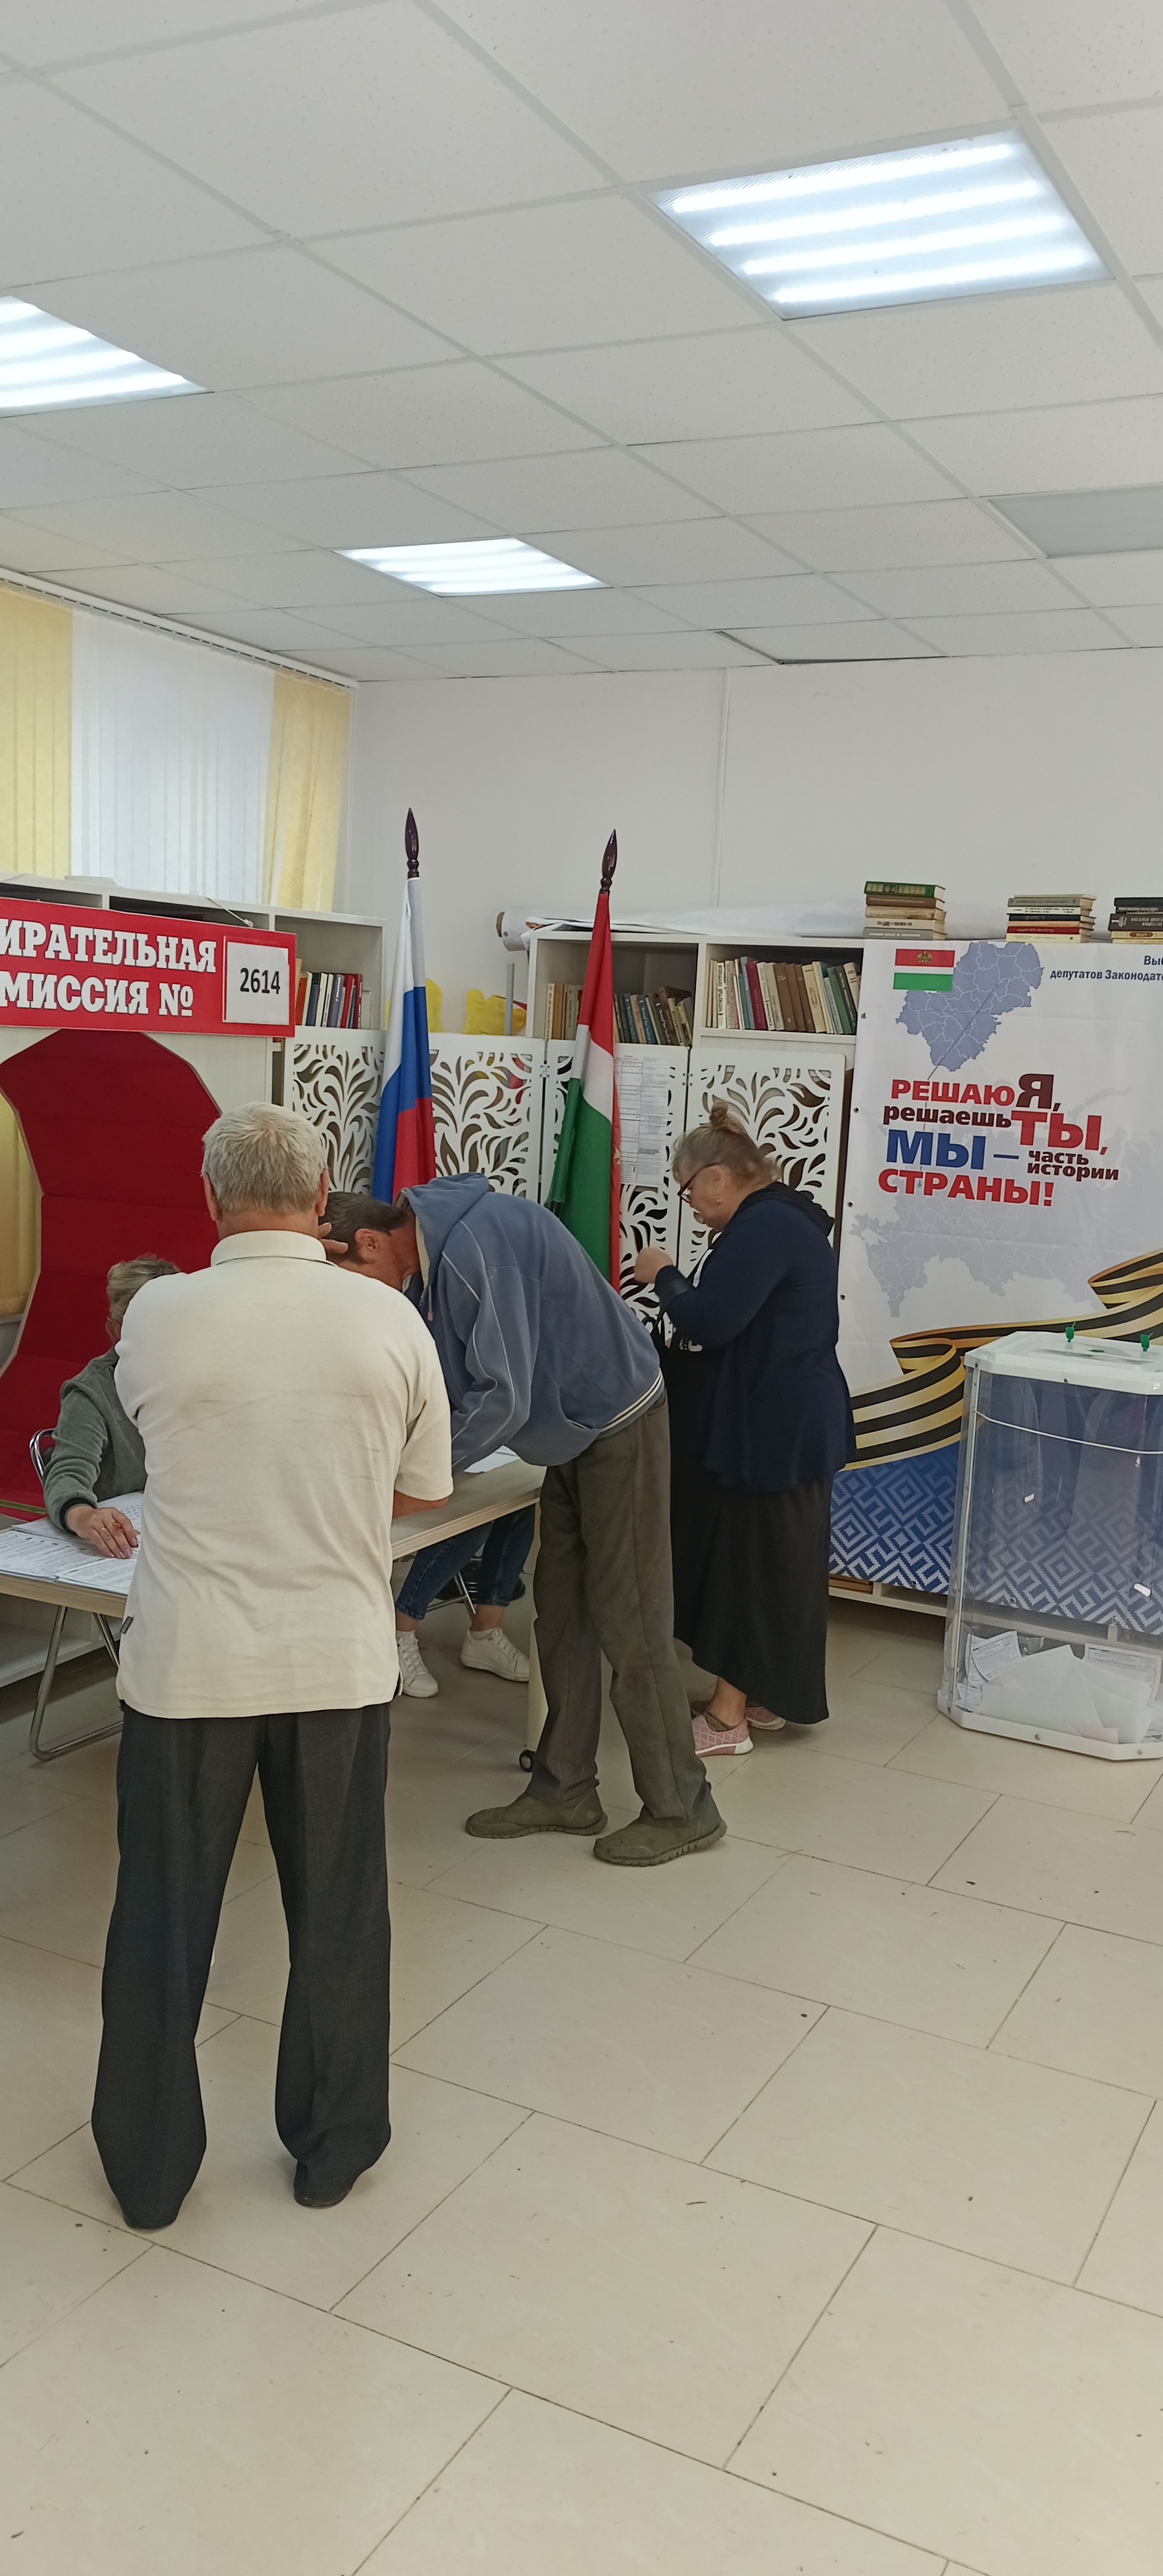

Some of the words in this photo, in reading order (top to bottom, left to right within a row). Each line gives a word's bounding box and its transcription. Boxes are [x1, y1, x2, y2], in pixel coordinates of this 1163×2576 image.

[0, 918, 216, 973] ИРАТЕЛЬНАЯ
[0, 970, 149, 1015] МИССИЯ
[158, 982, 194, 1017] №
[240, 968, 280, 995] 2614
[1050, 970, 1103, 981] депутатов
[891, 1079, 1015, 1106] РЕШАЮ
[1015, 1073, 1061, 1112] Я,
[883, 1106, 1012, 1128] решаешь
[1010, 1110, 1108, 1156] ТЫ,
[886, 1129, 986, 1170] МЫ
[1028, 1150, 1089, 1165] часть
[878, 1168, 1055, 1206] СТРАНЫ!
[1027, 1163, 1119, 1182] истории
